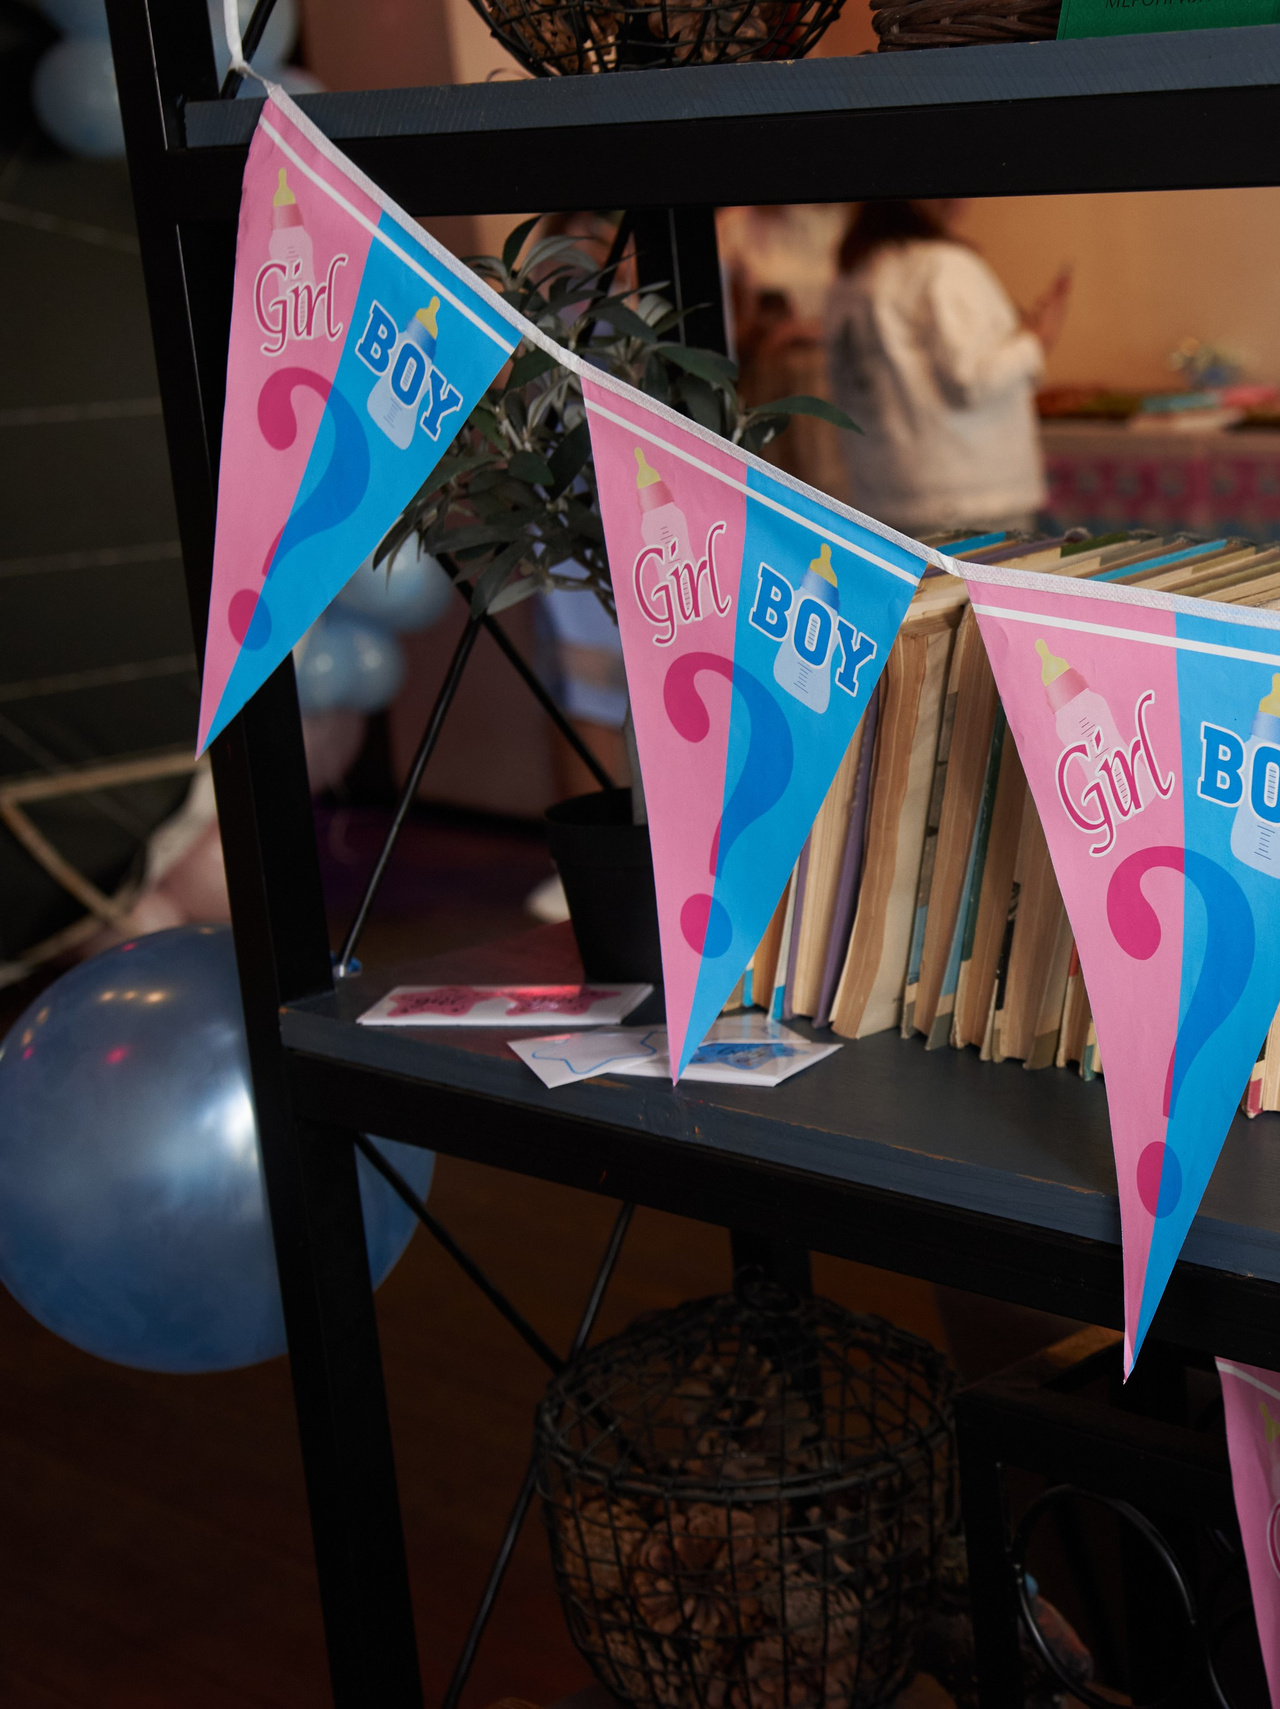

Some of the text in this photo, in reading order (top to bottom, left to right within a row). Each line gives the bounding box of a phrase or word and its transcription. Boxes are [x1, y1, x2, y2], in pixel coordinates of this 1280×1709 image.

[254, 252, 348, 357] Girl
[355, 299, 463, 441] BOY
[632, 520, 731, 647] Girl
[749, 562, 877, 697] BOY
[1054, 689, 1176, 857] Girl
